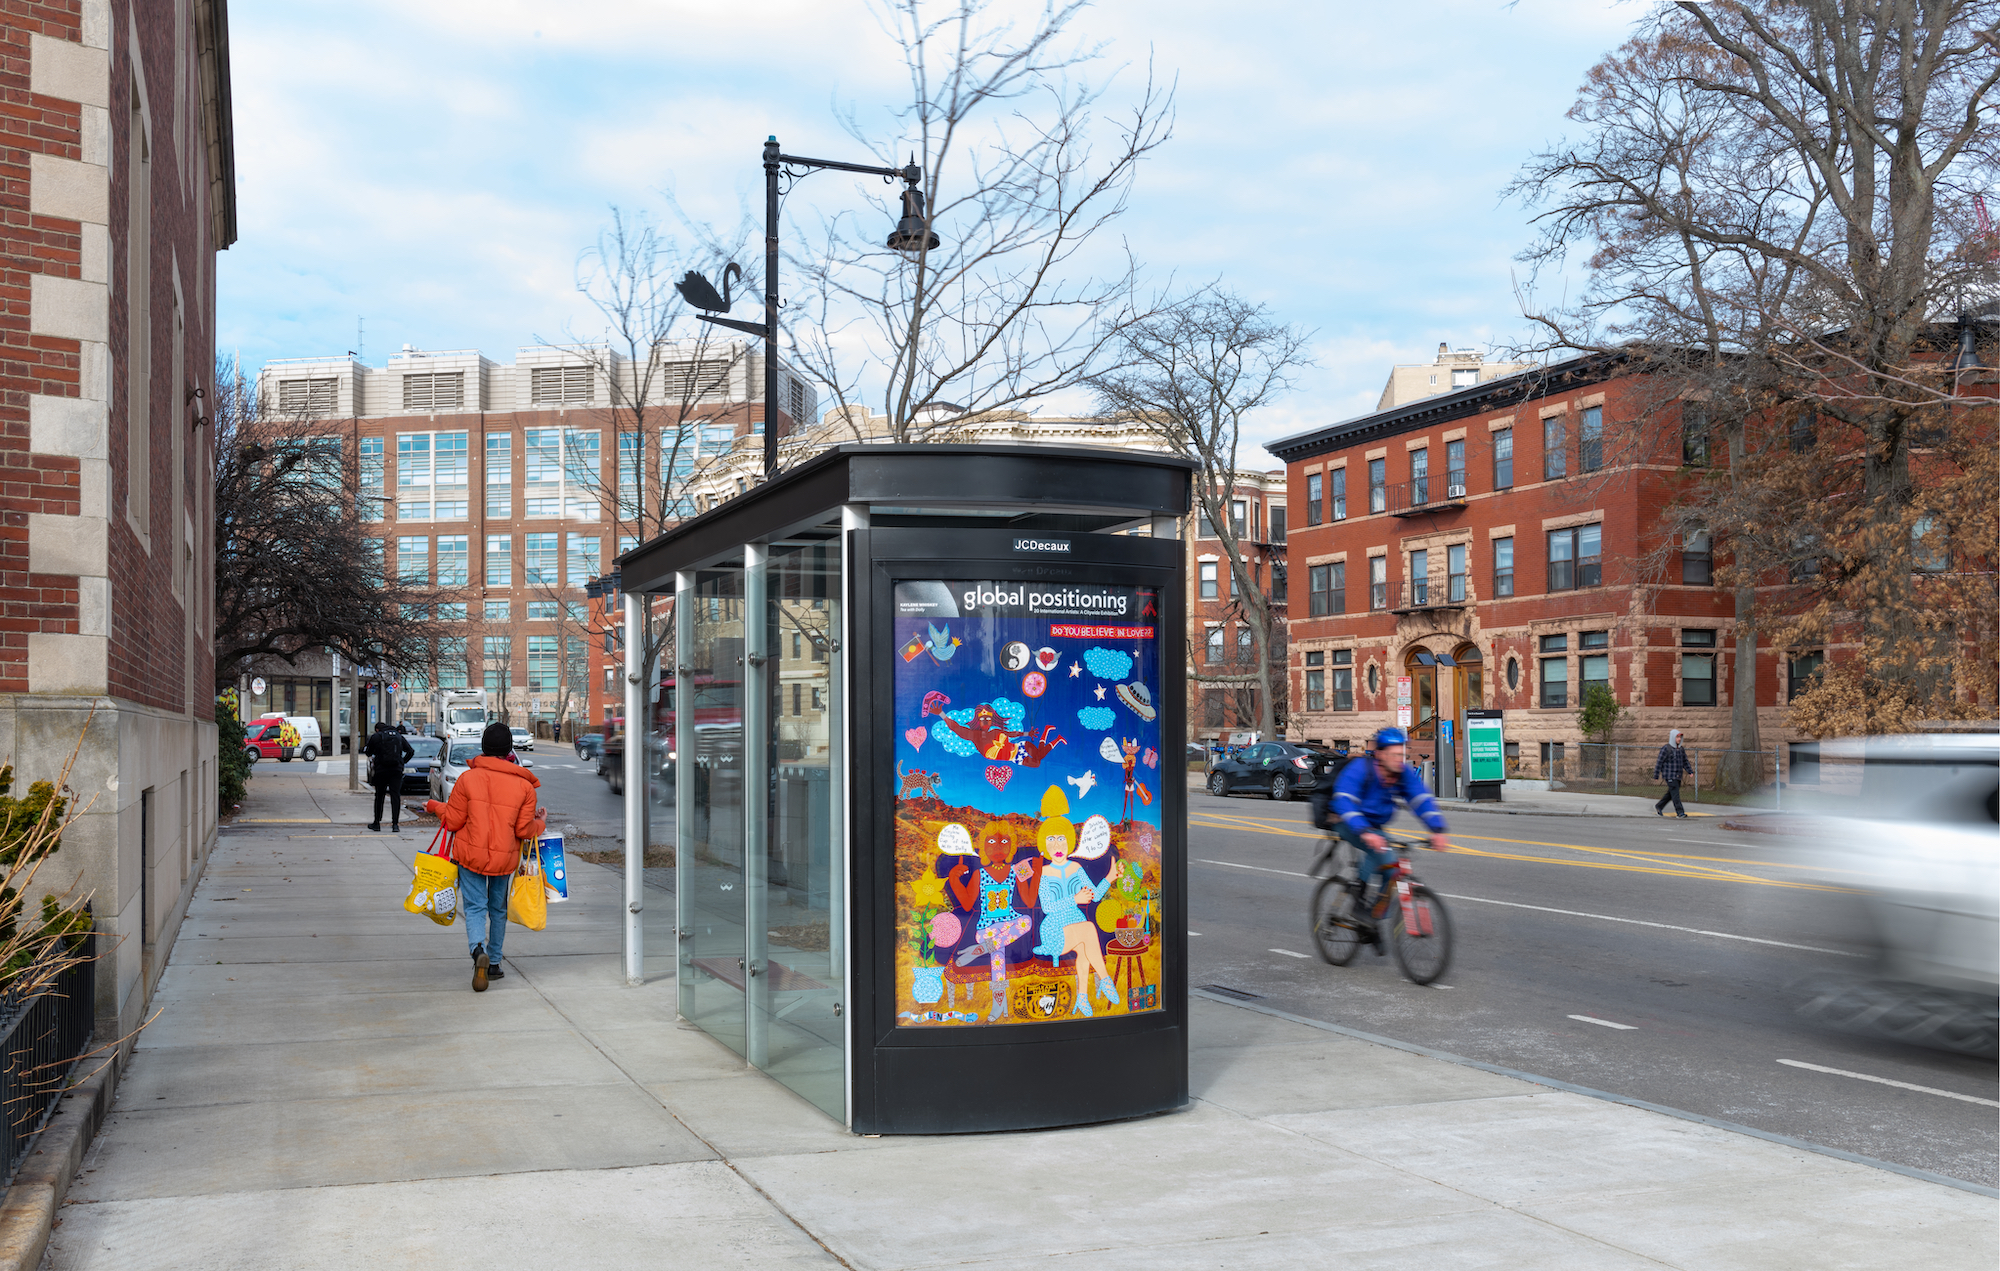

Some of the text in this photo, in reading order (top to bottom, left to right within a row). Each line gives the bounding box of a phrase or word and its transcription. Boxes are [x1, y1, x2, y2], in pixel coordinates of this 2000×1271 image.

[1015, 540, 1069, 551] JCDecaux
[964, 585, 1127, 615] global positioning
[1063, 626, 1080, 636] YOU
[1081, 627, 1114, 637] BELIEVE
[1117, 628, 1125, 637] IN
[1126, 628, 1151, 638] LOVE??
[917, 1011, 948, 1023] KAYLENE
